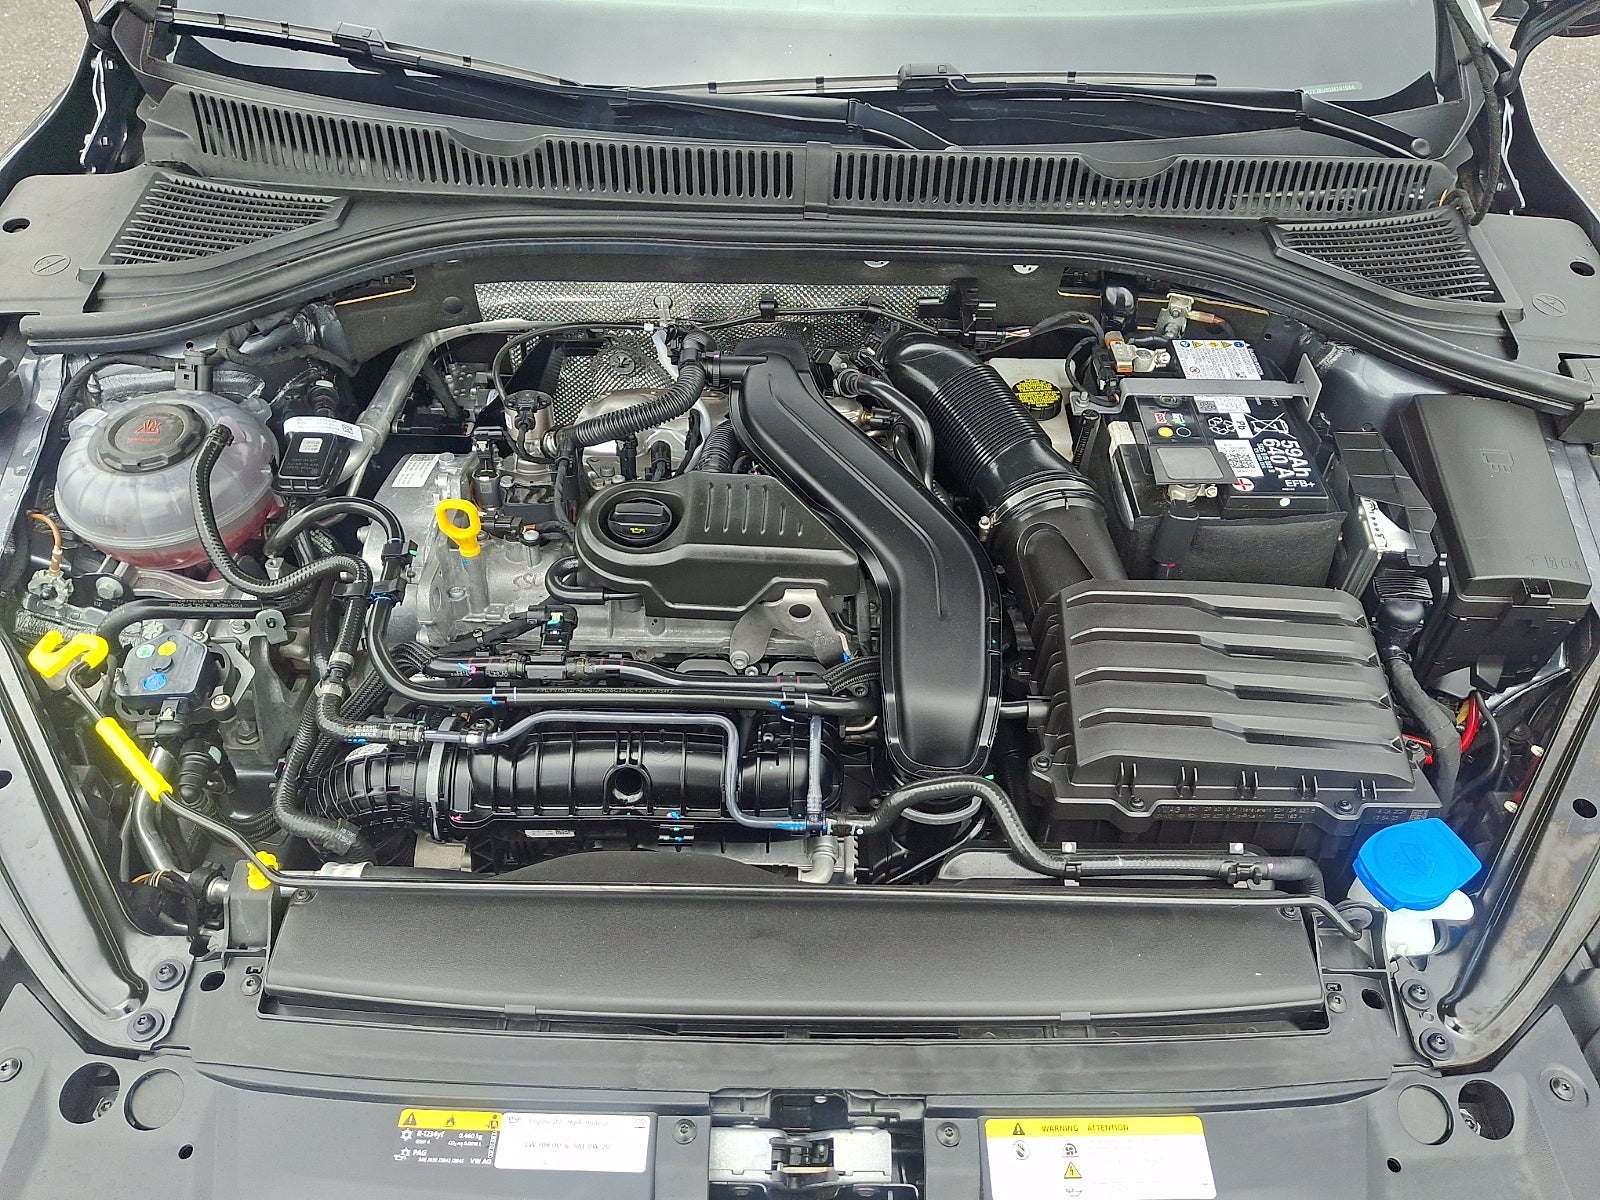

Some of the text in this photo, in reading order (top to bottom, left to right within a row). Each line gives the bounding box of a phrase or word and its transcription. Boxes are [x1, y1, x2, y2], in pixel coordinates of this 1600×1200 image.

[1236, 420, 1246, 430] Pb
[1262, 438, 1289, 464] 640
[1280, 439, 1312, 477] 59Ah
[1274, 466, 1295, 479] A
[1284, 479, 1316, 487] EFB+
[1041, 1123, 1129, 1132] WARNING ATTENTION
